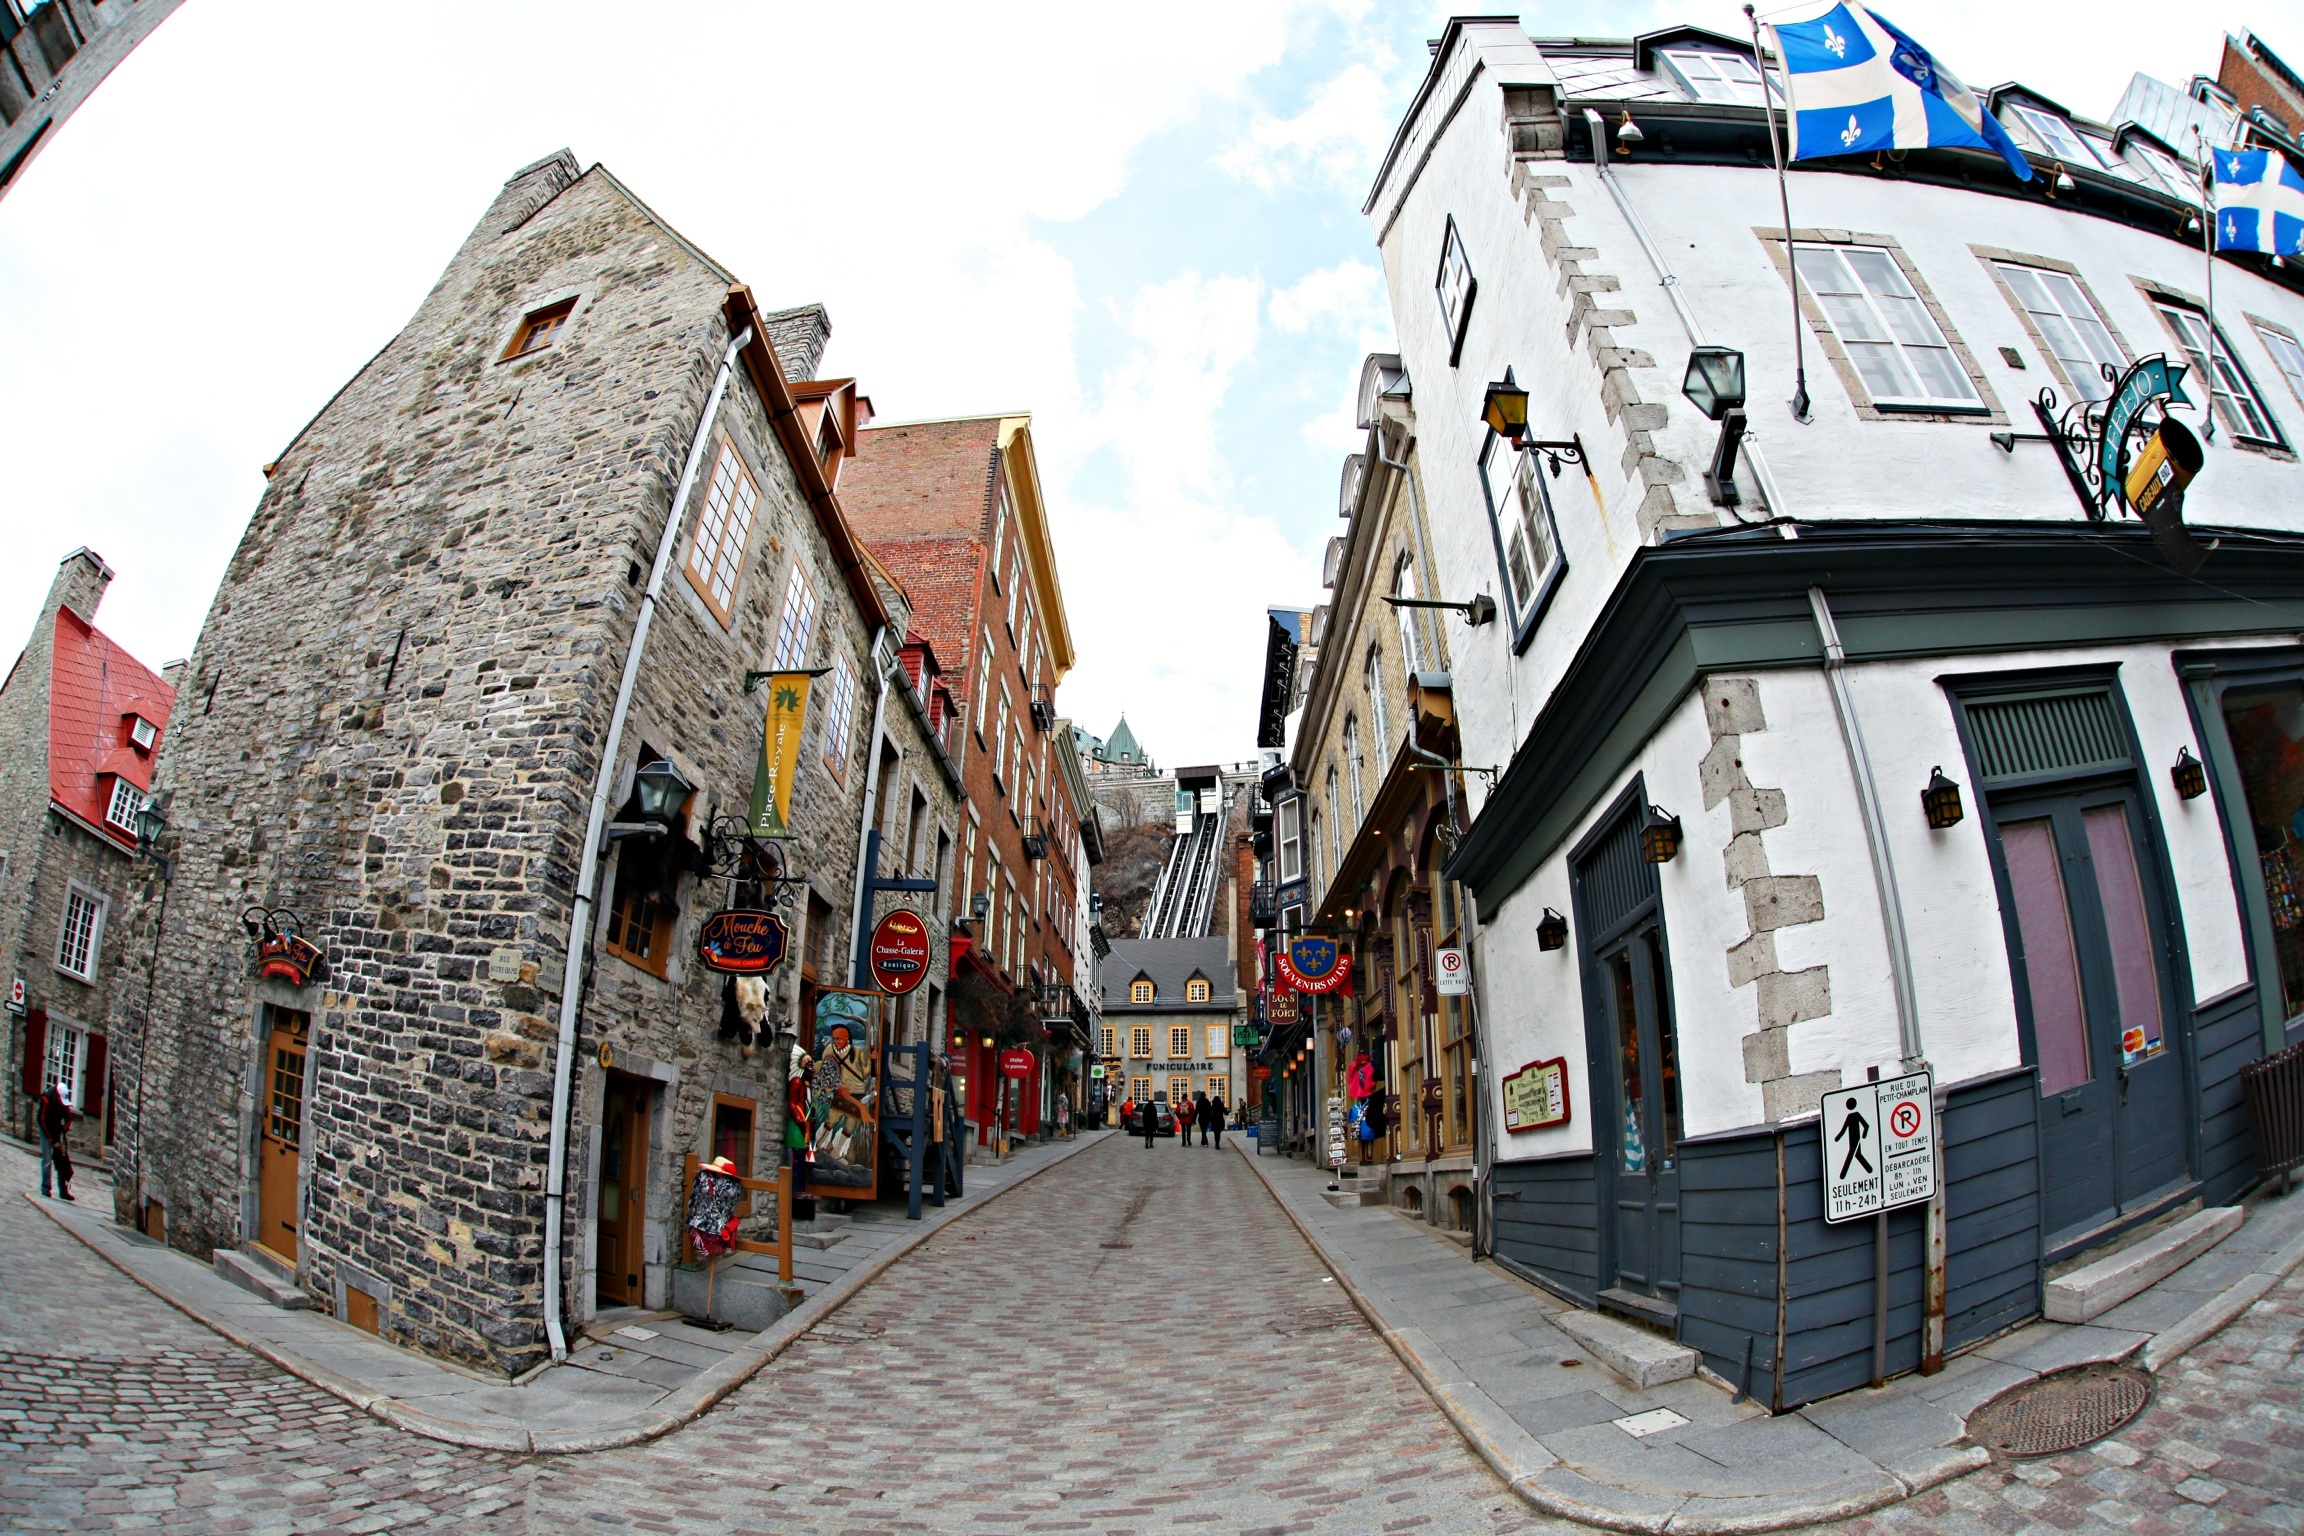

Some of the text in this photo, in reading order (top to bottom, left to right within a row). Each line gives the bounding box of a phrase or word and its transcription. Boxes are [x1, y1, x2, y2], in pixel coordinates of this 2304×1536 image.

[2106, 370, 2152, 453] FEEJO
[2138, 475, 2164, 513] CADEAUX
[760, 723, 786, 828] Place-Royale
[709, 914, 769, 939] Mouche
[723, 935, 764, 955] à Feu
[876, 945, 925, 955] Chasse-Galerie
[499, 955, 511, 963] RUE
[883, 961, 915, 969] Boutique
[545, 965, 556, 975] RUE
[1278, 958, 1327, 991] SOUVENIRS
[1326, 974, 1339, 986] DU
[1335, 958, 1349, 977] LYS
[1271, 1009, 1296, 1018] FORT
[1146, 1062, 1214, 1071] FUNICULAIRE
[1880, 1085, 1928, 1103] PETIT-CHAMPLAIN
[1890, 1080, 1916, 1092] RUE DU
[1884, 1136, 1929, 1153] EN TOUT TEMPS
[1894, 1172, 1903, 1180] 8h
[1912, 1167, 1922, 1176] 11h
[1832, 1176, 1879, 1199] SEULEMENT
[1889, 1180, 1904, 1191] LUN
[1912, 1175, 1928, 1185] VEN
[1890, 1184, 1927, 1201] SEULEMENT
